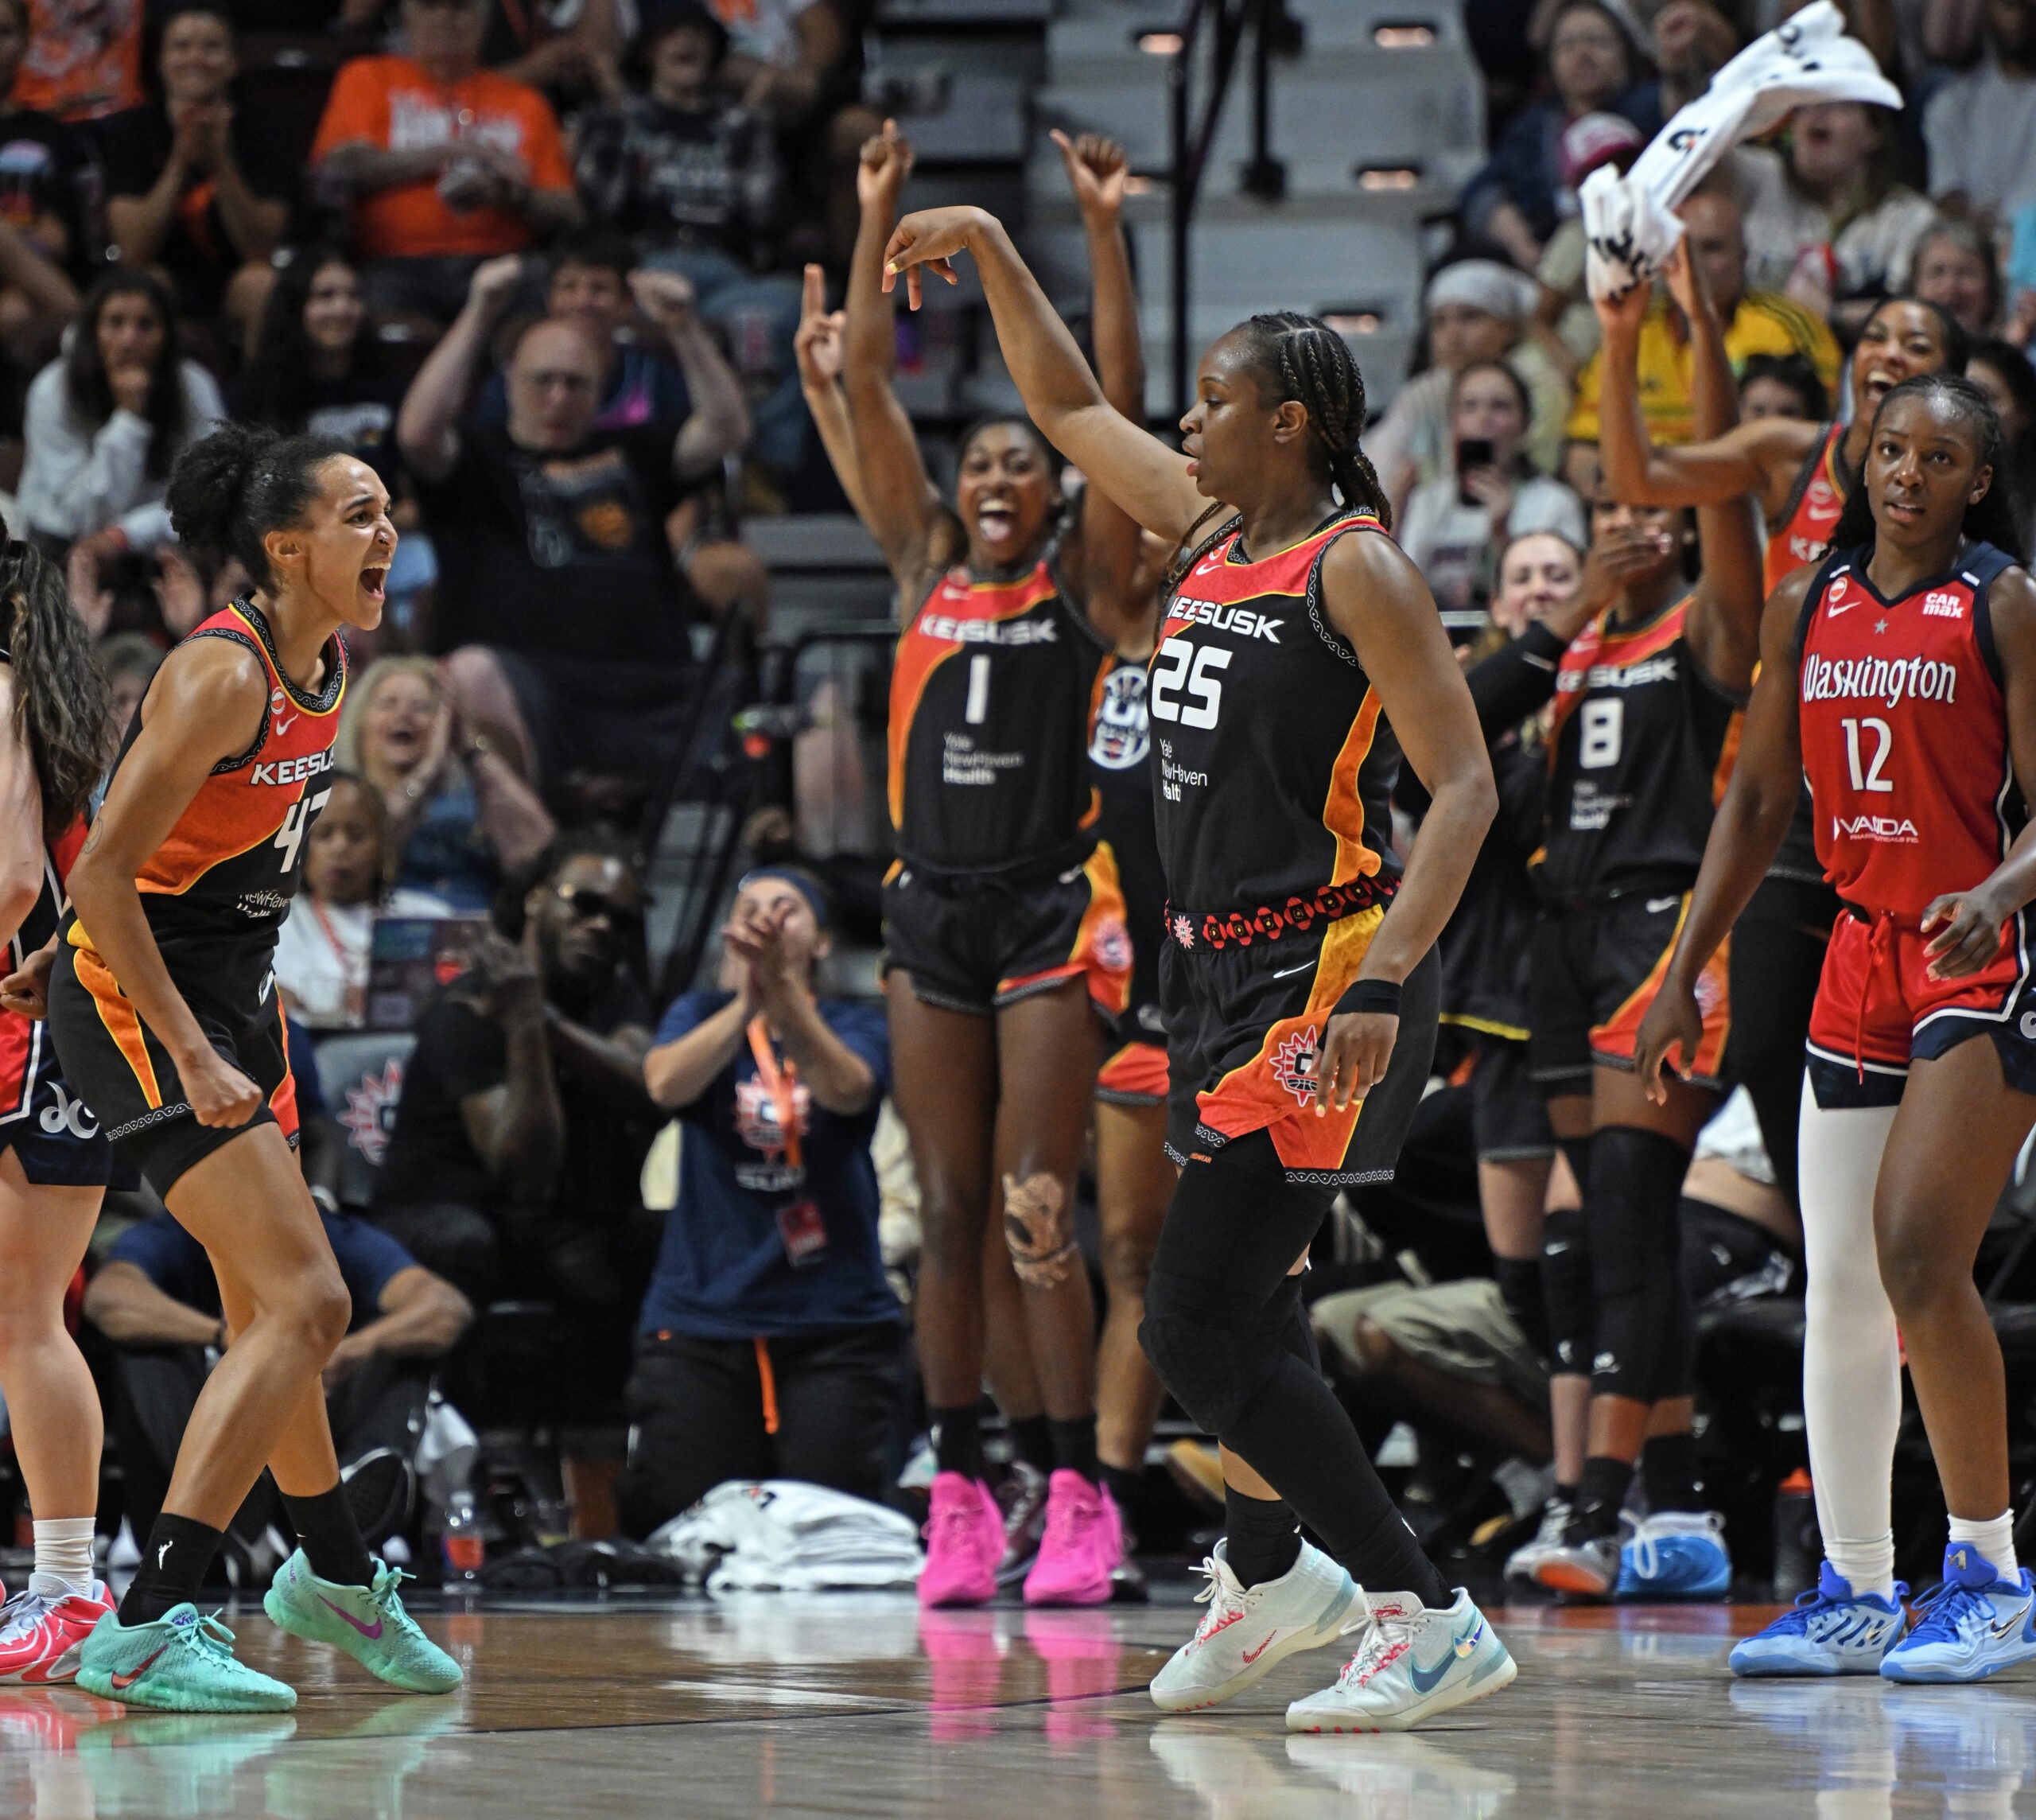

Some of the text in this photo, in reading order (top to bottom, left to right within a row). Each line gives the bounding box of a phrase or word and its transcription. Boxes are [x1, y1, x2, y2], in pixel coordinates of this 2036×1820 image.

[1167, 596, 1285, 644] EESUSK
[1922, 603, 1964, 619] max
[1925, 592, 1960, 608] CAR
[966, 654, 991, 725] 1
[1152, 637, 1234, 730] 25
[1803, 653, 1957, 710] Washington
[1579, 696, 1625, 769] 8
[1841, 718, 1894, 792] 12
[250, 746, 334, 786] KEESU
